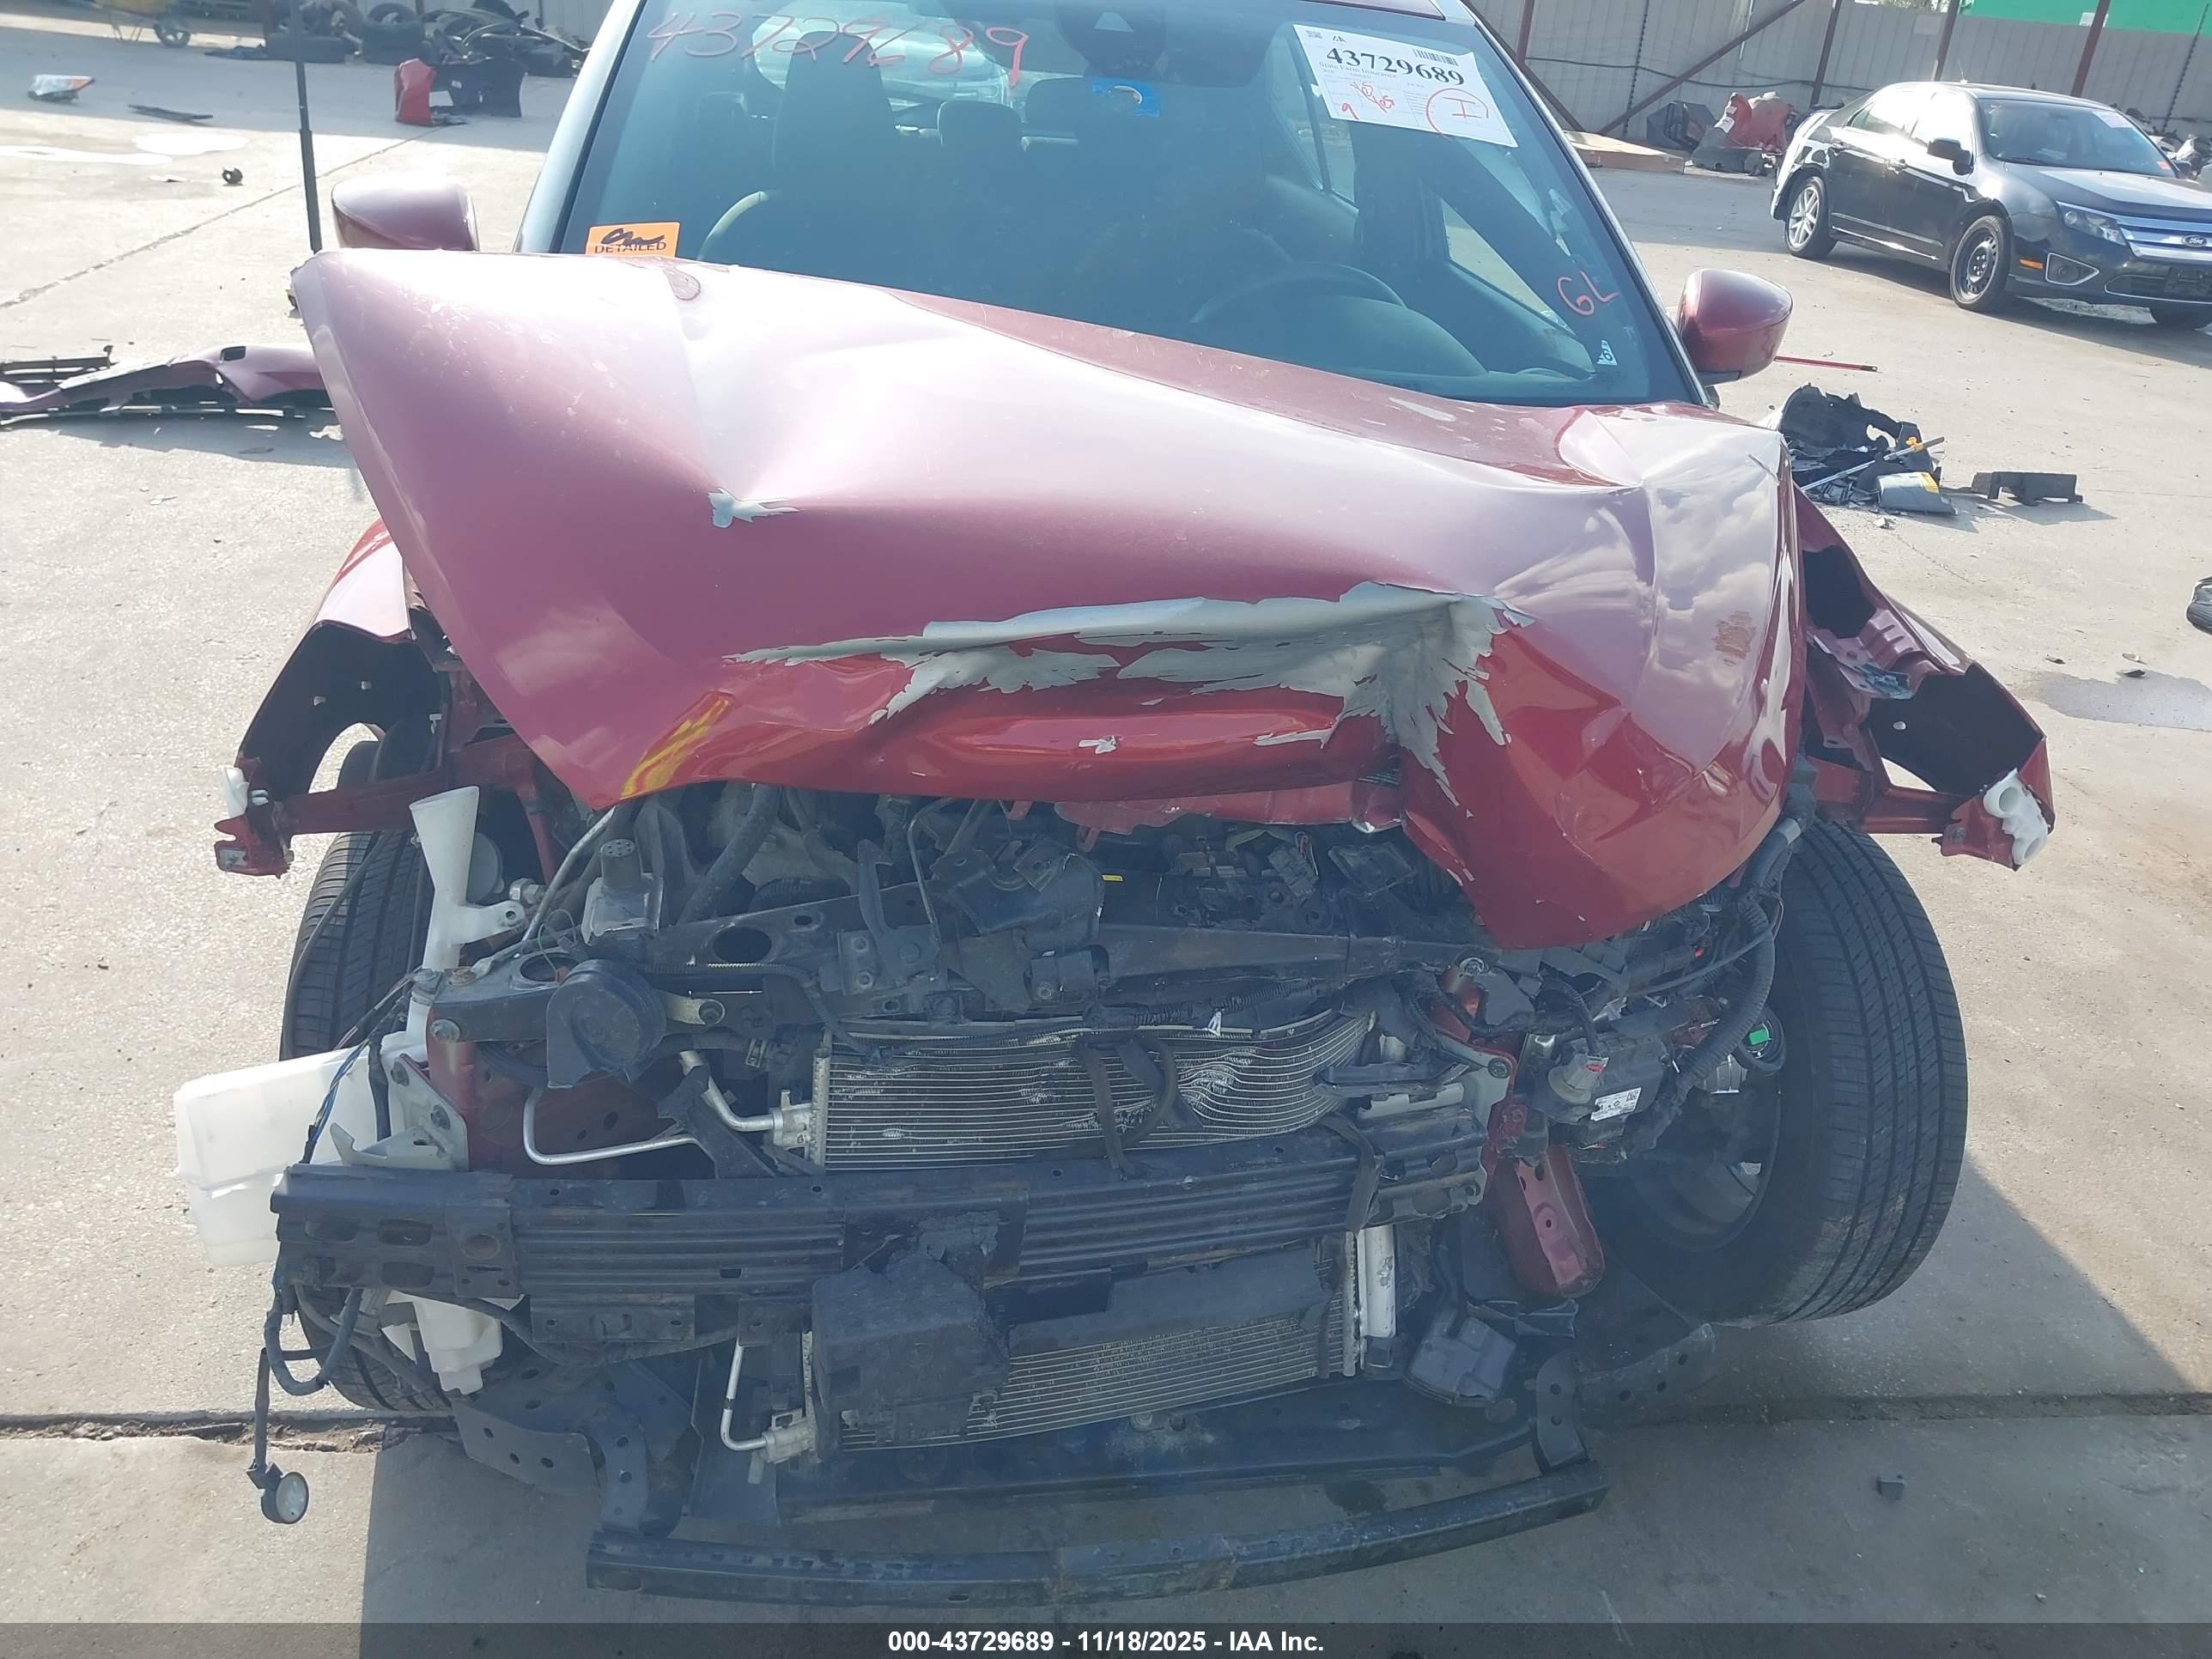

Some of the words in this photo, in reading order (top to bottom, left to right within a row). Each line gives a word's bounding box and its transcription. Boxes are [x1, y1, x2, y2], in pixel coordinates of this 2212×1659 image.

[647, 12, 1029, 88] 43729689
[1326, 47, 1465, 86] 43729689
[1361, 68, 1397, 78] Insurance
[594, 241, 667, 254] DETAILED
